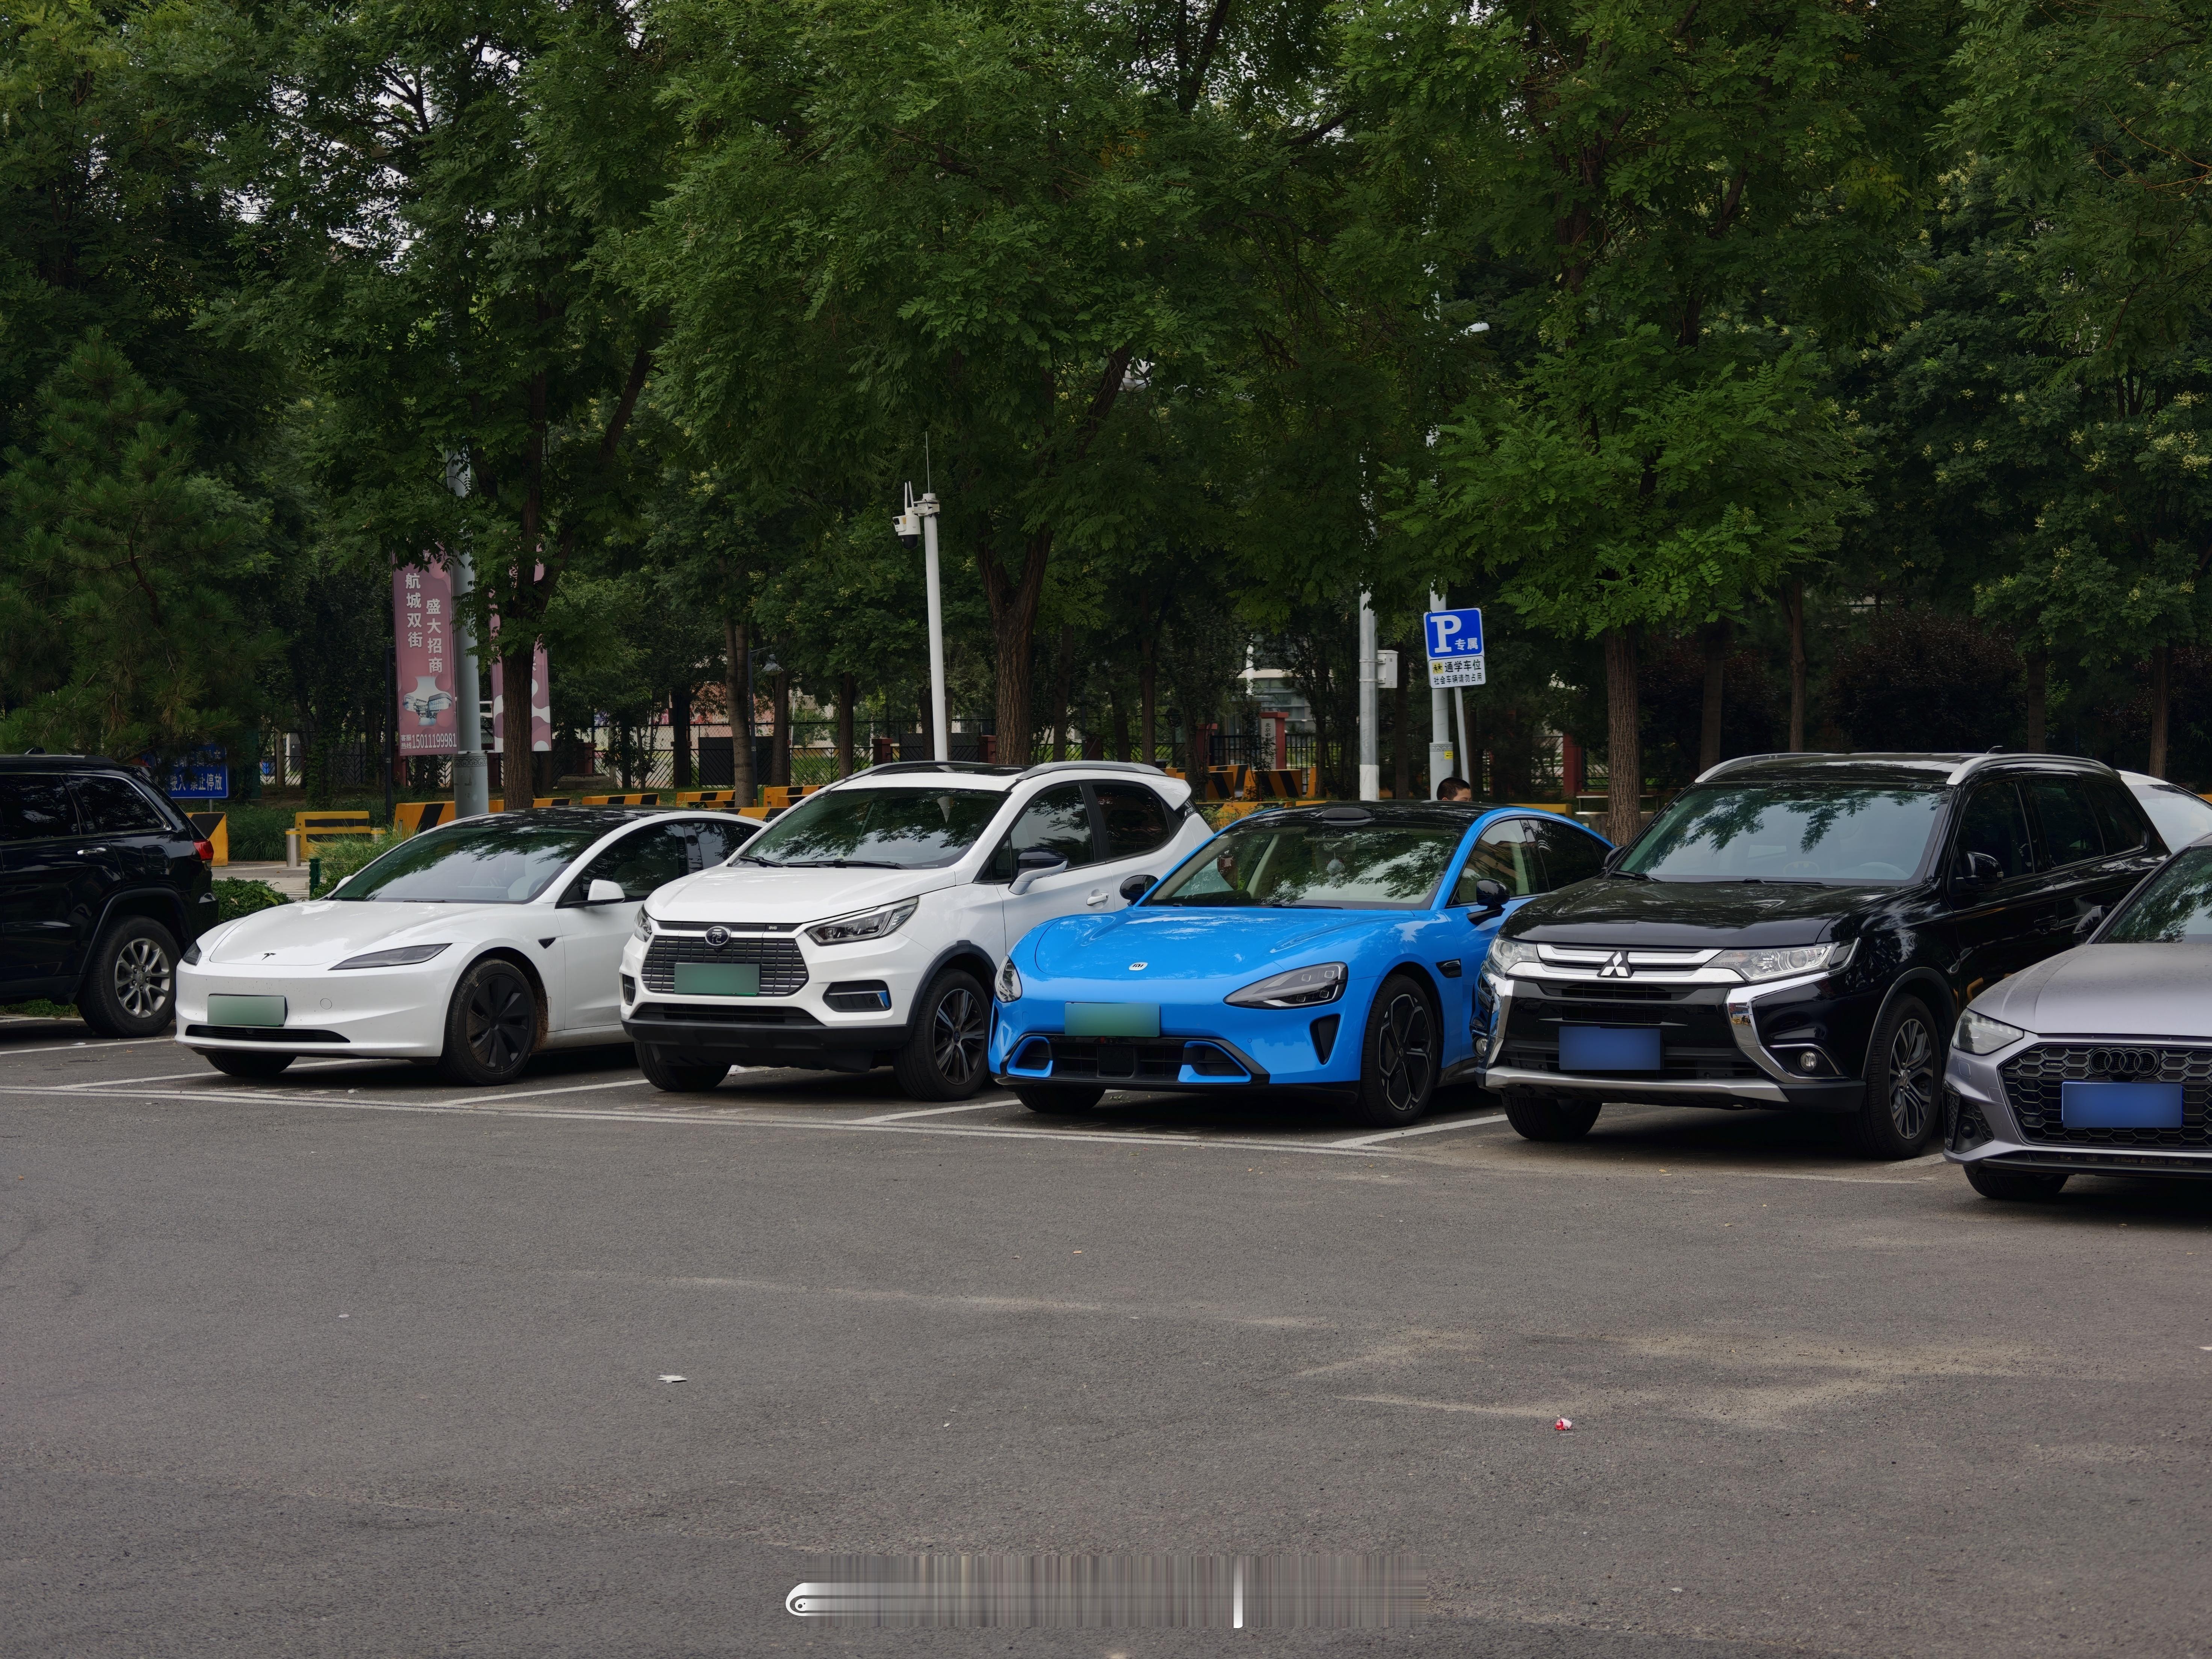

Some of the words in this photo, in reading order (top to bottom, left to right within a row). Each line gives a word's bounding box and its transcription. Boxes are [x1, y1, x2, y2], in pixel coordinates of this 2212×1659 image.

[405, 573, 423, 648] 航城双街
[426, 598, 443, 673] 盛大招商
[1430, 615, 1461, 653] P
[1455, 638, 1478, 650] 专属
[1444, 659, 1481, 672] 通学车位
[1434, 673, 1482, 685] 社会车辆请勿占用
[412, 733, 457, 749] 15011199981
